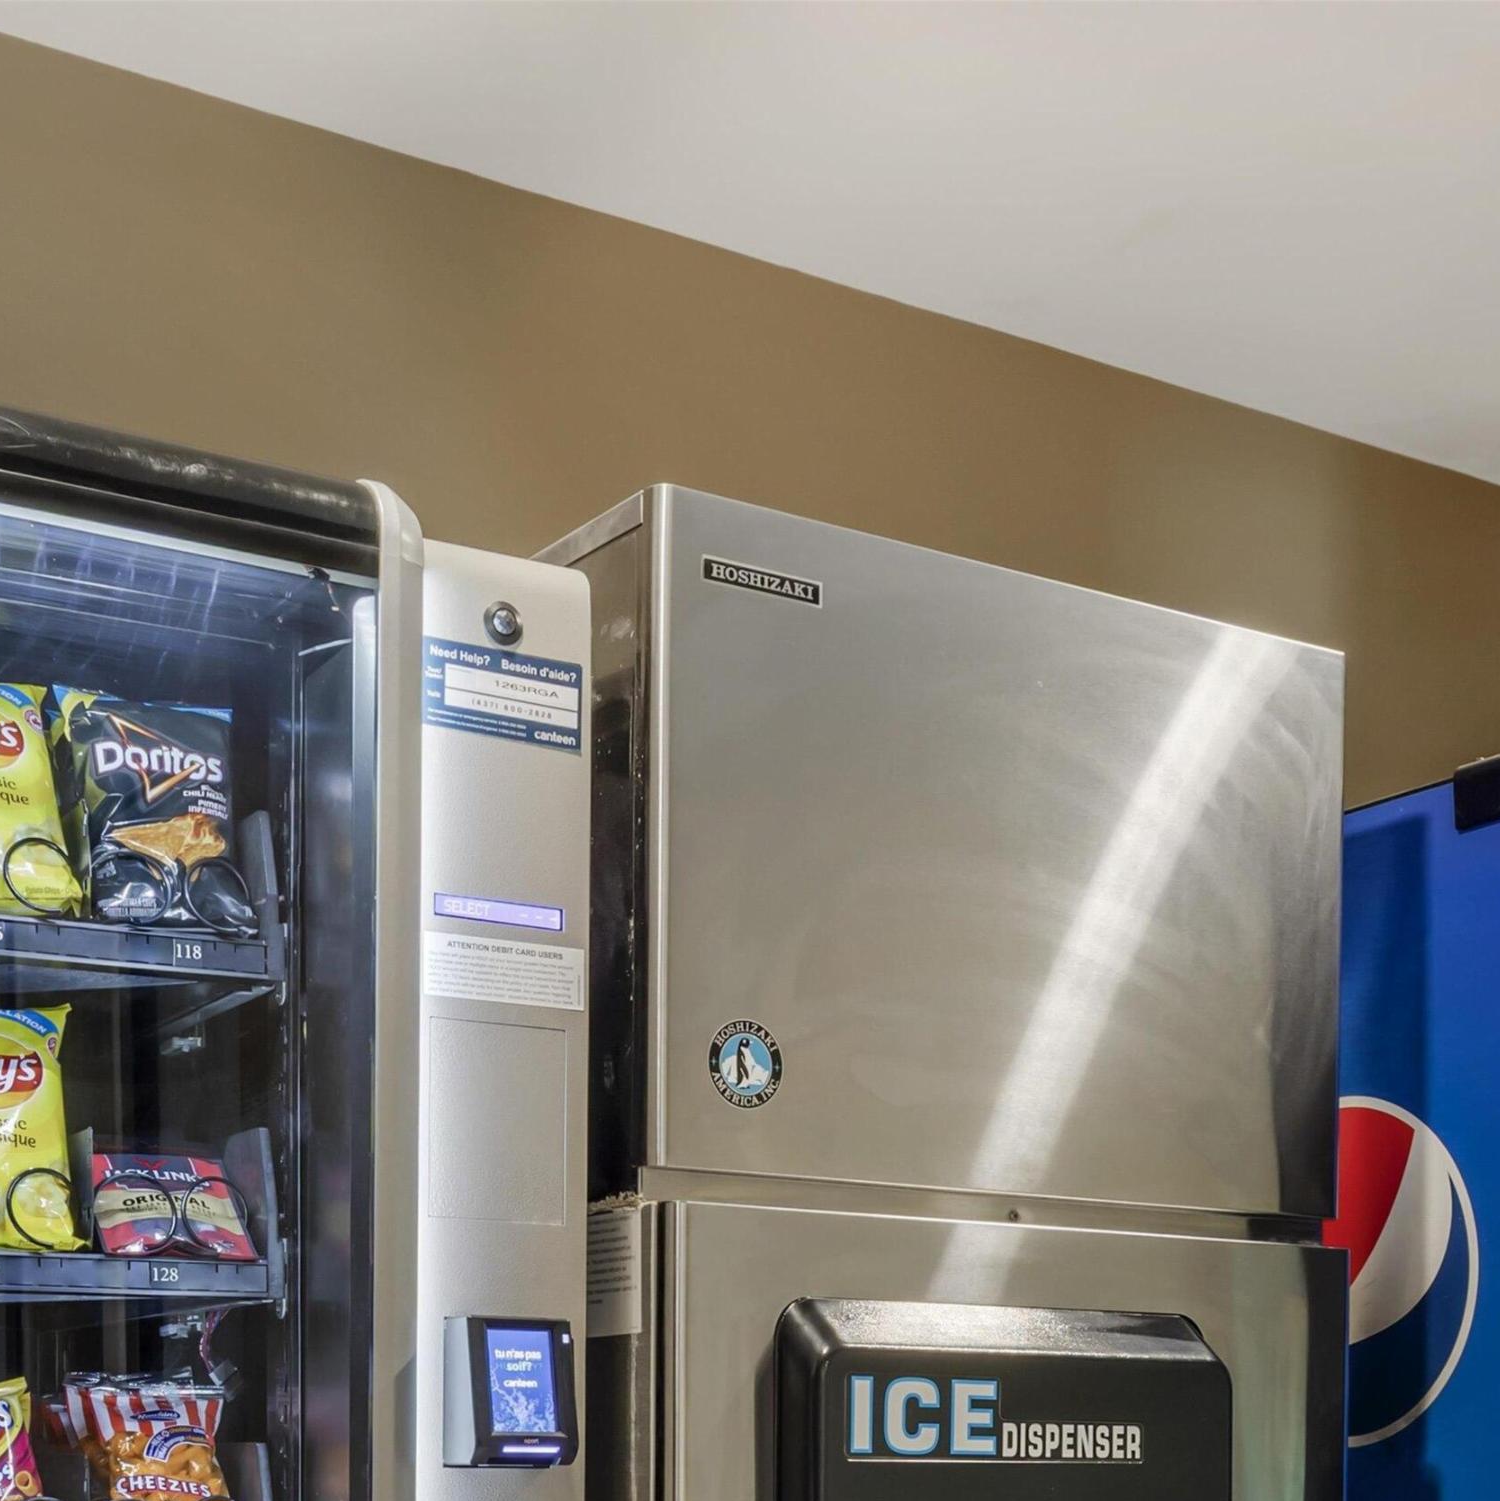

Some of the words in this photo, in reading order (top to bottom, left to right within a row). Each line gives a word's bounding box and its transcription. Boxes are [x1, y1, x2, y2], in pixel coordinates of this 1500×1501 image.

[710, 563, 815, 600] HOSHIZAKI
[429, 645, 457, 660] Need
[459, 650, 491, 666] Help?
[501, 659, 537, 677] Besoin
[539, 666, 577, 682] d'aide?
[534, 730, 577, 746] canteen
[93, 740, 223, 783] Doritos
[443, 899, 491, 917] SELECT
[175, 941, 202, 960] 118
[447, 940, 490, 952] ATTENTION
[491, 945, 513, 955] DEBIT
[515, 947, 537, 958] CARD
[538, 950, 564, 961] USERS
[714, 1021, 779, 1052] HOSHIZAKI
[122, 1193, 211, 1210] ORIGNAL
[152, 1266, 180, 1282] 128
[503, 1378, 538, 1388] canteen
[850, 1375, 998, 1456] ICE
[1002, 1421, 1142, 1460] DISPENSER
[115, 1476, 212, 1498] CHEEZIES
